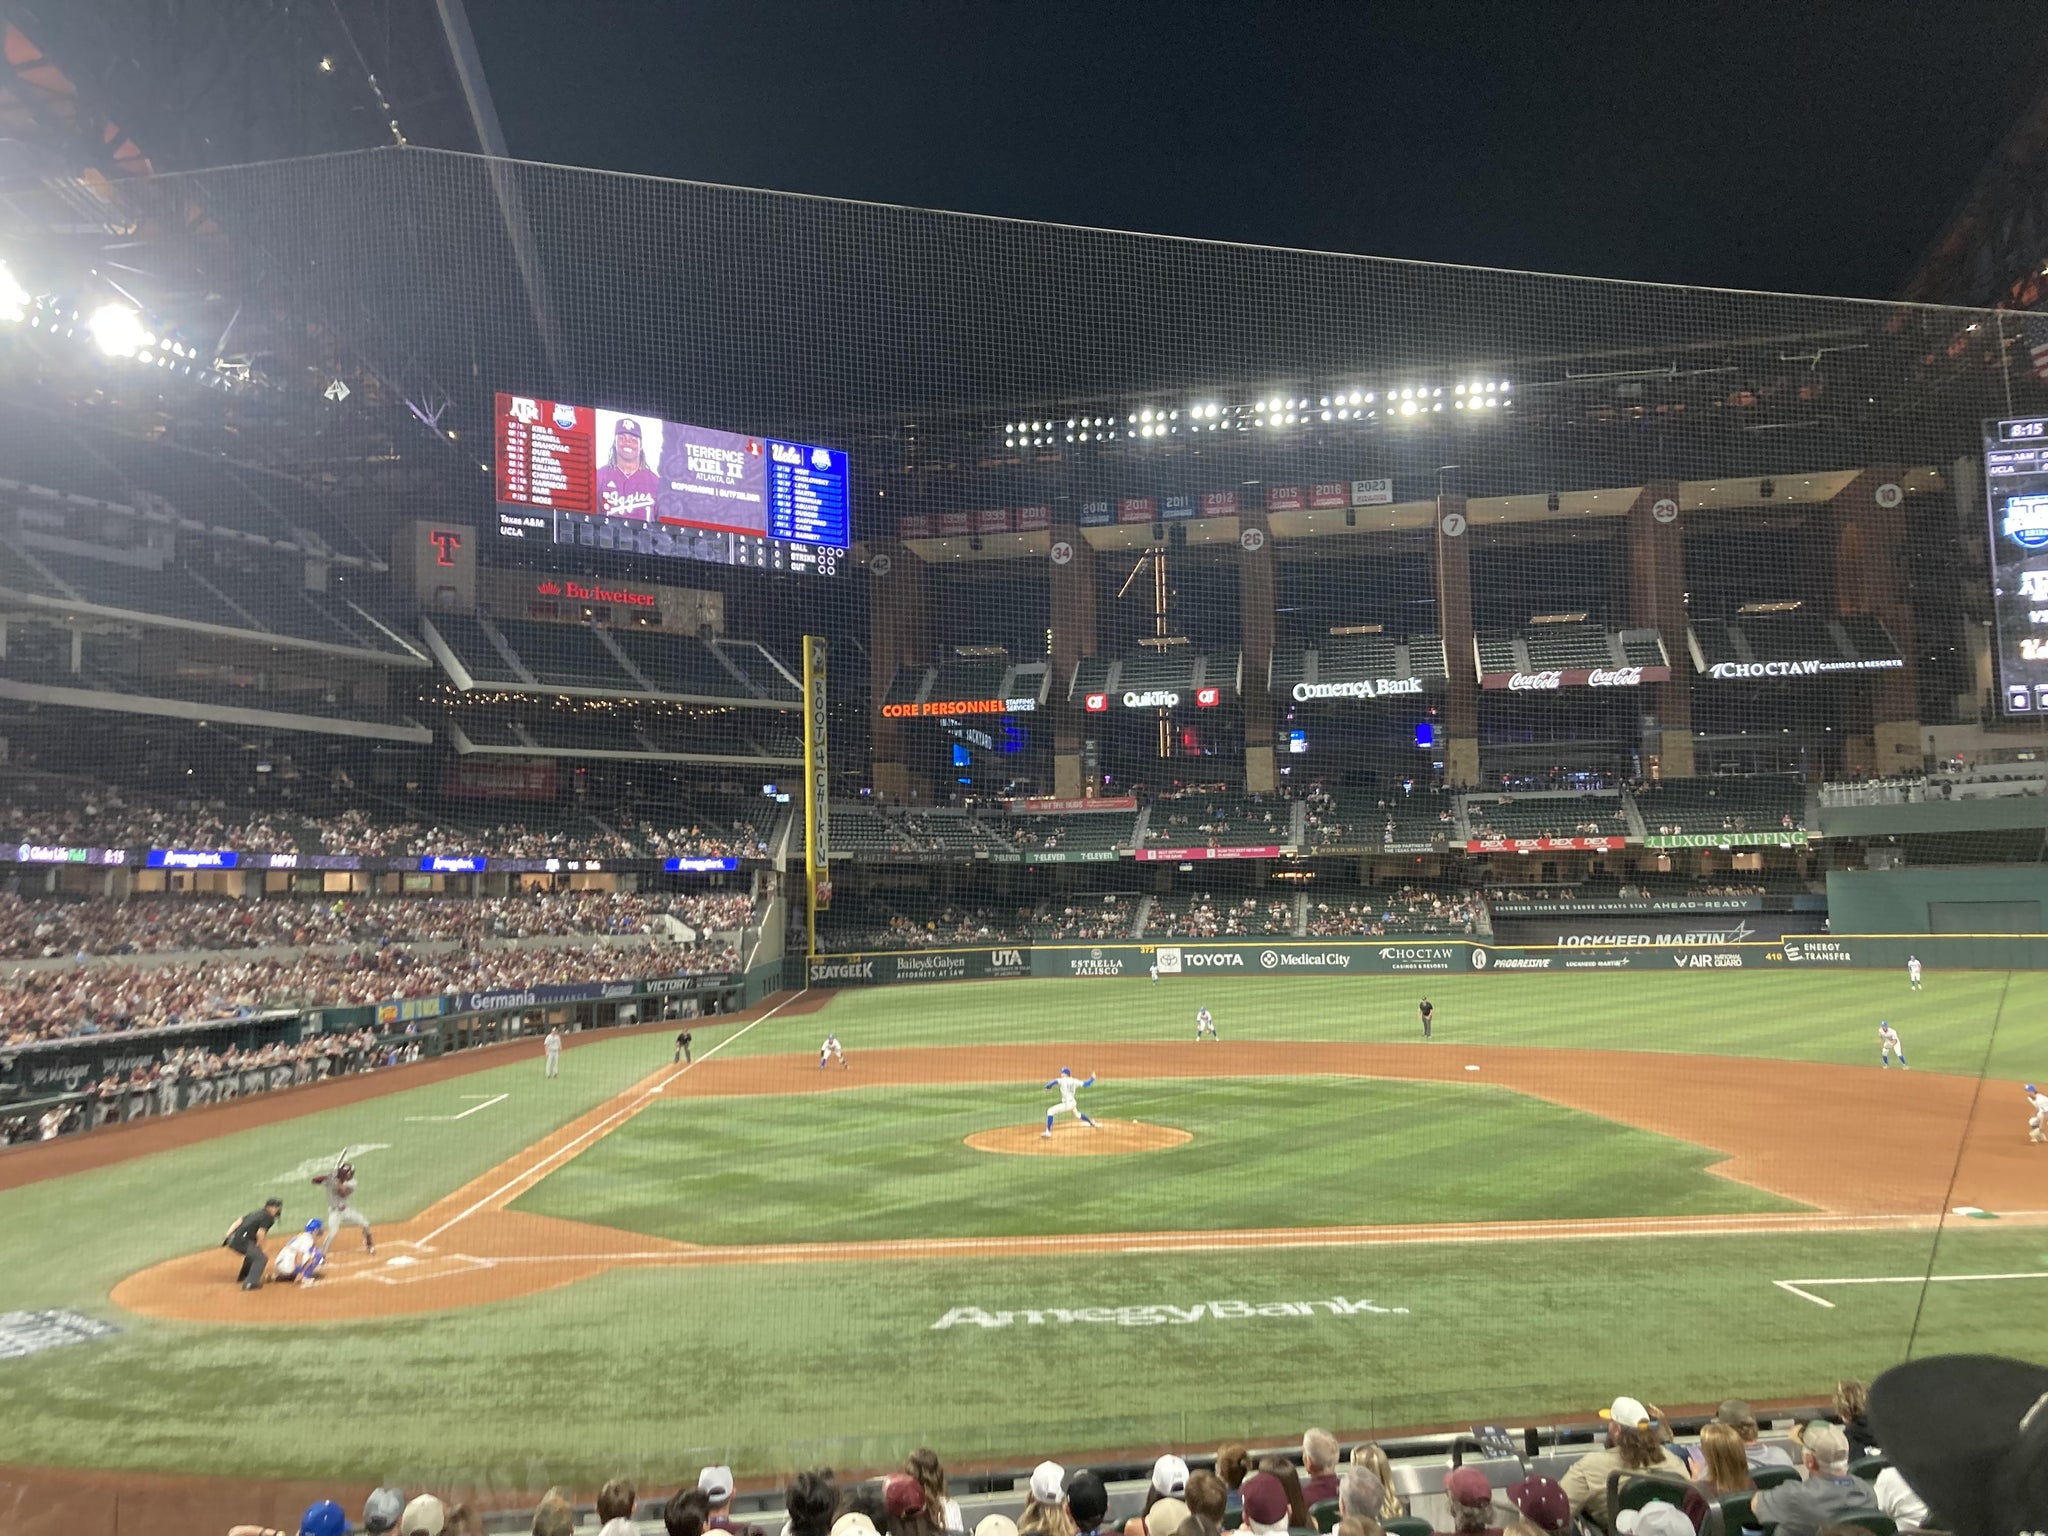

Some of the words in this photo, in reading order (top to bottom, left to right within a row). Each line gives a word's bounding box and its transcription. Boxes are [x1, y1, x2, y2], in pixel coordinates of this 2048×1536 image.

[2011, 423, 2043, 437] 8:15
[685, 443, 745, 465] TERRENCE
[687, 457, 724, 475] KIEL
[727, 462, 743, 478] II
[1991, 465, 2014, 473] UCLA
[1316, 484, 1342, 496] 2016
[1357, 480, 1386, 492] 2023
[1208, 492, 1233, 504] 2012
[1272, 487, 1297, 499] 2015
[1880, 488, 1896, 502] 10
[1083, 502, 1107, 513] 2010
[1126, 499, 1148, 510] 2011
[1166, 496, 1188, 508] 2011
[1022, 507, 1046, 518] 2010
[1656, 503, 1675, 518] 29
[500, 514, 522, 526] Texas
[522, 517, 545, 528] A&M
[1450, 518, 1459, 532] 7
[500, 527, 523, 538] UCLA
[1244, 533, 1261, 545] 26
[429, 530, 461, 566] T
[791, 542, 808, 552] BALL
[1054, 547, 1069, 559] 34
[791, 553, 816, 563] STRIKE
[791, 562, 806, 571] OUT
[1720, 660, 1819, 678] CHOCTAW
[1819, 661, 1856, 670] CASINOS
[1857, 661, 1864, 669] &
[1864, 659, 1902, 668] RESORTS
[1508, 671, 1563, 690] Coca-Cola
[1588, 666, 1643, 687] Coca-Cola
[1376, 677, 1423, 695] Bank
[1005, 698, 1035, 706] STAFFING
[1088, 696, 1104, 709] QT
[1123, 691, 1179, 708] QuikTrip
[1198, 690, 1215, 704] QT
[815, 682, 824, 740] ROOT
[883, 704, 919, 717] CORE
[922, 700, 1005, 716] PERSONNEL
[1006, 704, 1035, 712] SERVICES
[815, 773, 825, 863] CHIKIN
[1480, 840, 1505, 848] DEX
[1514, 839, 1539, 847] DEX
[1549, 838, 1574, 846] DEX
[1583, 837, 1609, 846] DEX
[1661, 834, 1719, 847] LUXOR
[1722, 832, 1803, 846] STAFFING
[53, 846, 68, 861] Life
[270, 854, 297, 868] MPH
[1557, 935, 1650, 947] LOCKHEED
[1656, 933, 1725, 945] MARTIN
[1140, 946, 1155, 954] 372
[1804, 943, 1840, 951] ENERGY
[992, 950, 1022, 966] UTA
[1184, 953, 1243, 966] TOYOTA
[1386, 948, 1453, 959] CHOCTAW
[1765, 953, 1782, 961] 410
[1804, 952, 1851, 961] TRANSFER
[1071, 959, 1123, 968] ESTRELLA
[1281, 954, 1325, 965] Medical
[1326, 953, 1350, 967] City
[1493, 958, 1550, 968] PROGRESSIVE
[1689, 954, 1712, 967] AIR
[1714, 959, 1742, 967] GUARD
[810, 961, 873, 981] SEATGEEK
[897, 971, 935, 979] ATTORNEYS
[1075, 967, 1118, 975] JALISCO
[646, 978, 691, 993] VICTORY
[470, 990, 535, 1010] Germania
